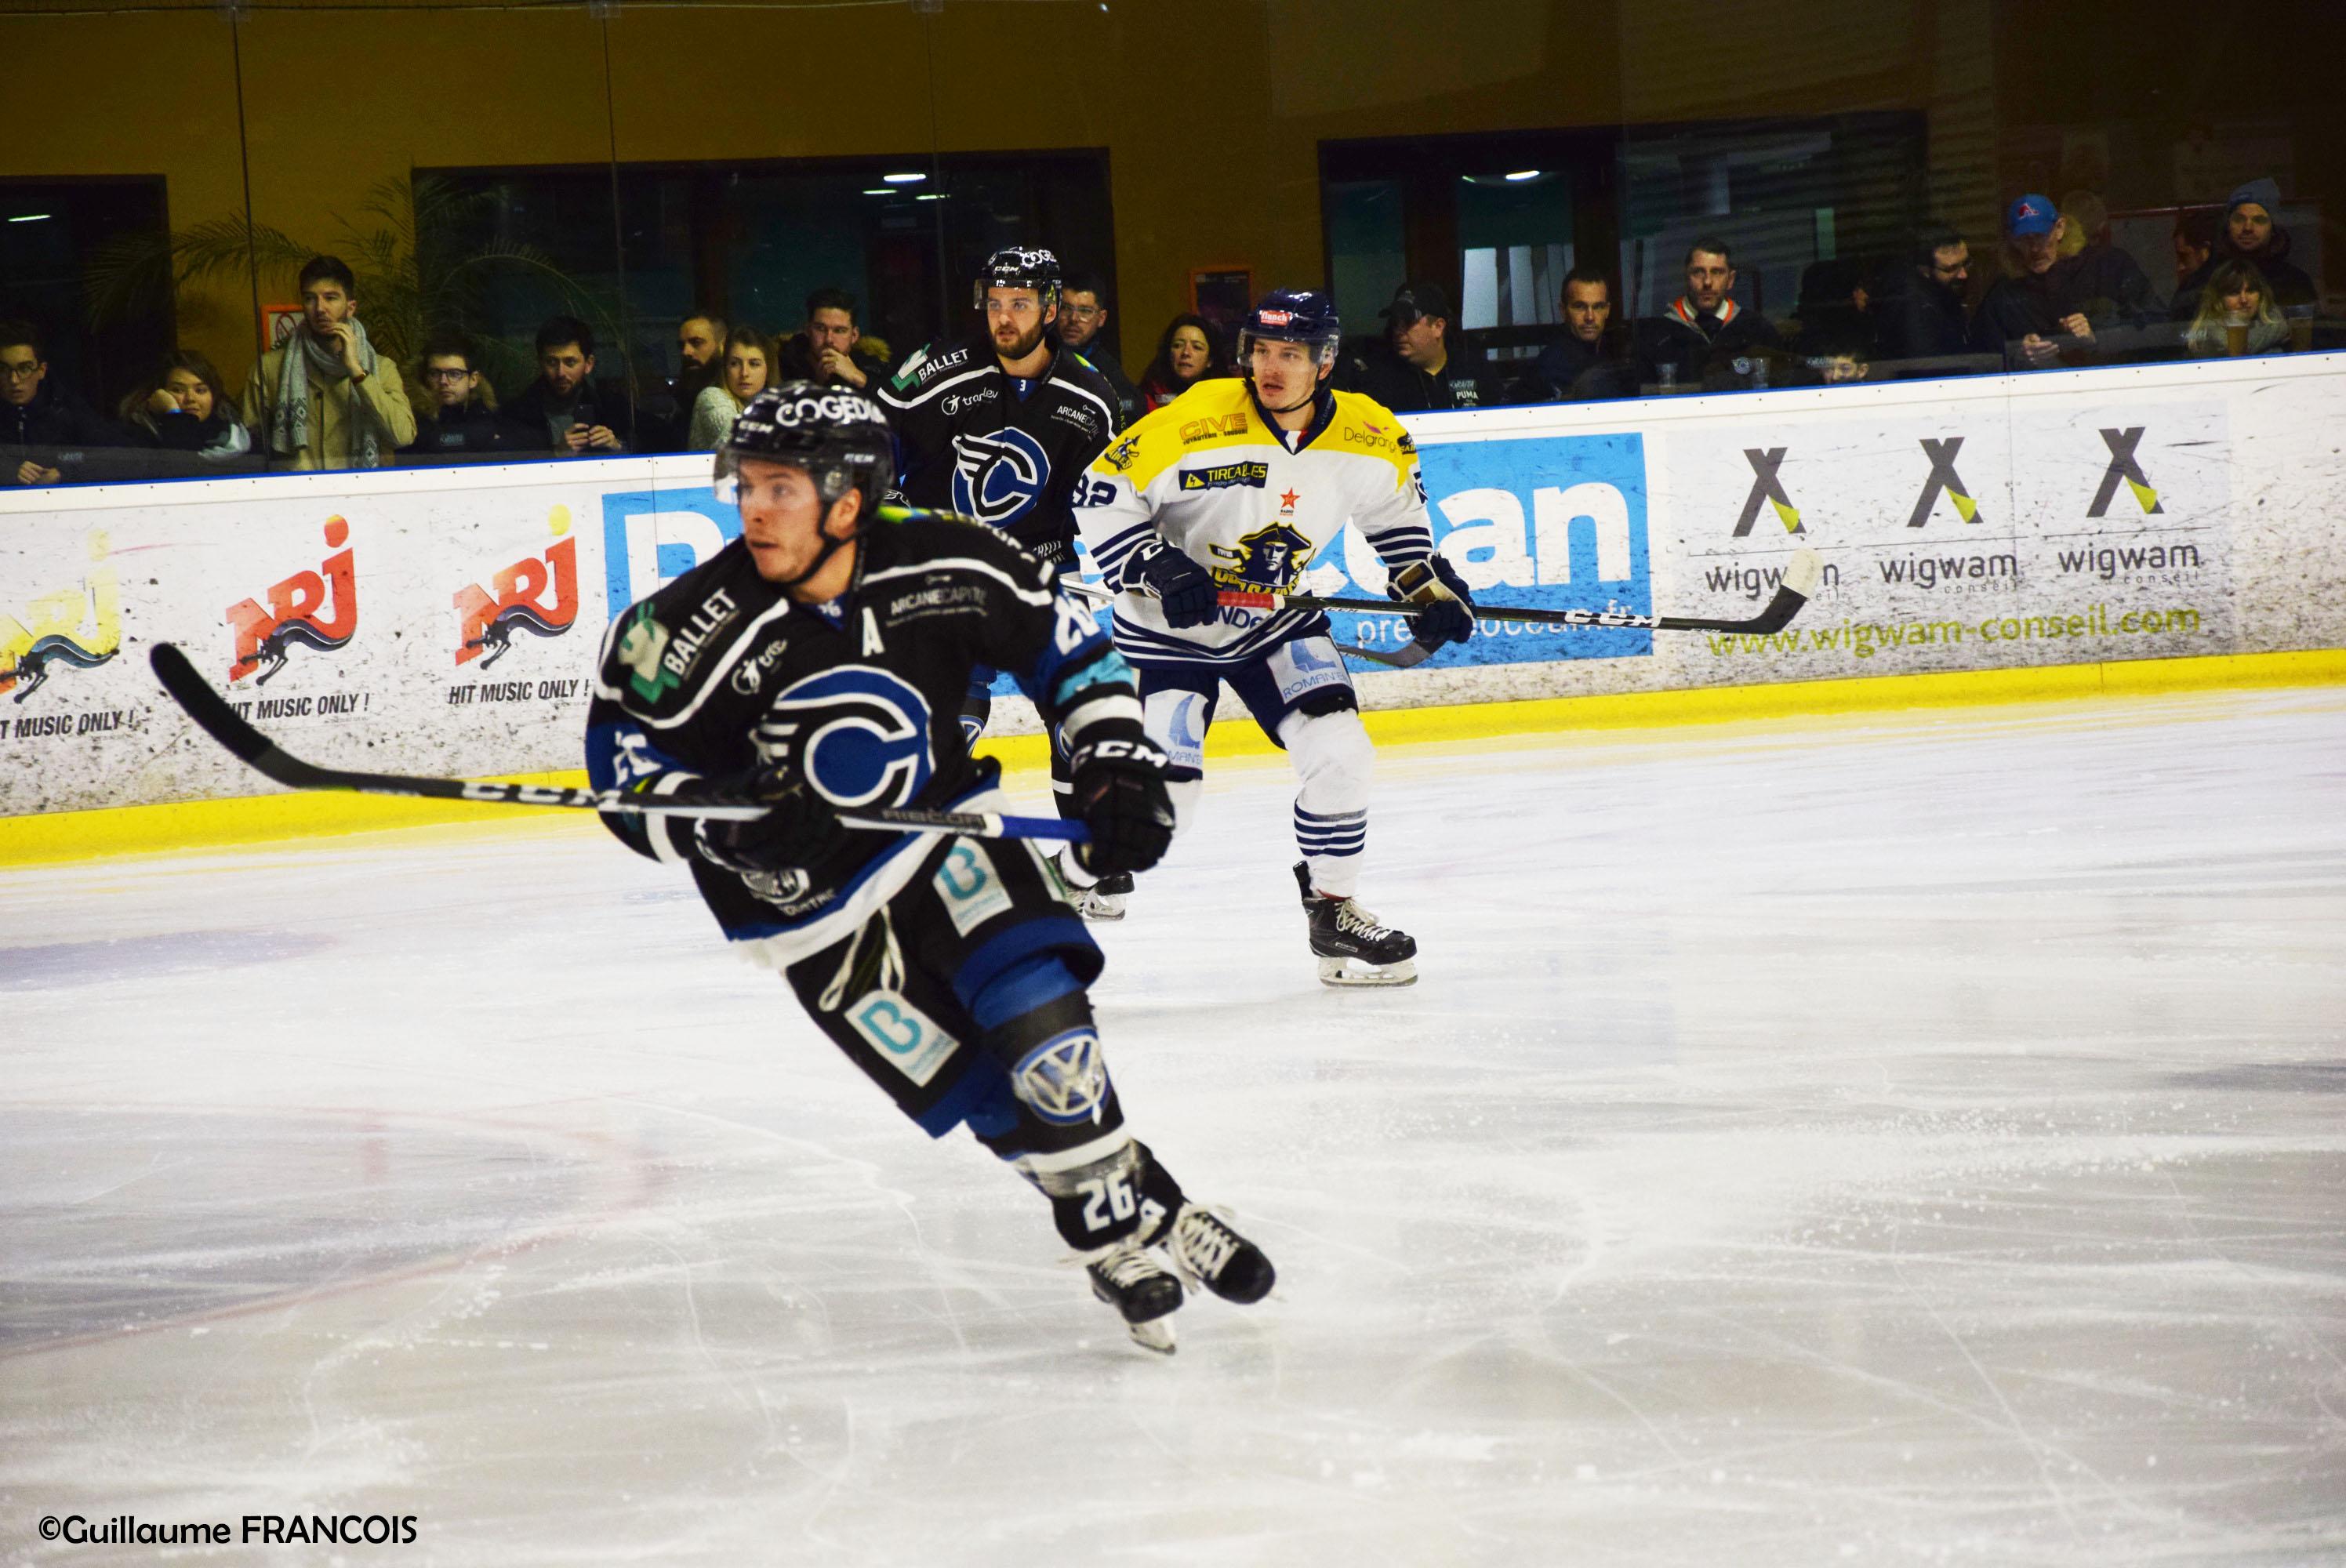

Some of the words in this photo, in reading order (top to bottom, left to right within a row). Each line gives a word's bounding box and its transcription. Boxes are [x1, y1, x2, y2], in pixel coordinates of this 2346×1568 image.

[918, 348, 968, 383] BALLET
[1456, 390, 1479, 400] PUMA
[1179, 412, 1248, 440] CIVE
[1879, 552, 2017, 589] wigwam
[2058, 542, 2200, 580] wigwam
[1944, 578, 2017, 594] conseil
[2123, 570, 2199, 585] conseil
[664, 586, 737, 676] BALLET
[862, 607, 886, 657] A
[1564, 608, 1664, 630] CCM
[1705, 602, 2201, 659] www.wigwam-conseil.com
[256, 696, 312, 720] MUSIC
[318, 693, 359, 715] ONLY
[448, 685, 477, 705] HIT
[480, 681, 533, 703] MUSIC
[538, 679, 579, 700] ONLY
[15, 714, 74, 739] MUSIC
[78, 710, 123, 734] ONLY
[1070, 740, 1167, 774] CCM
[461, 782, 624, 811] CCM
[1077, 1168, 1136, 1233] 26
